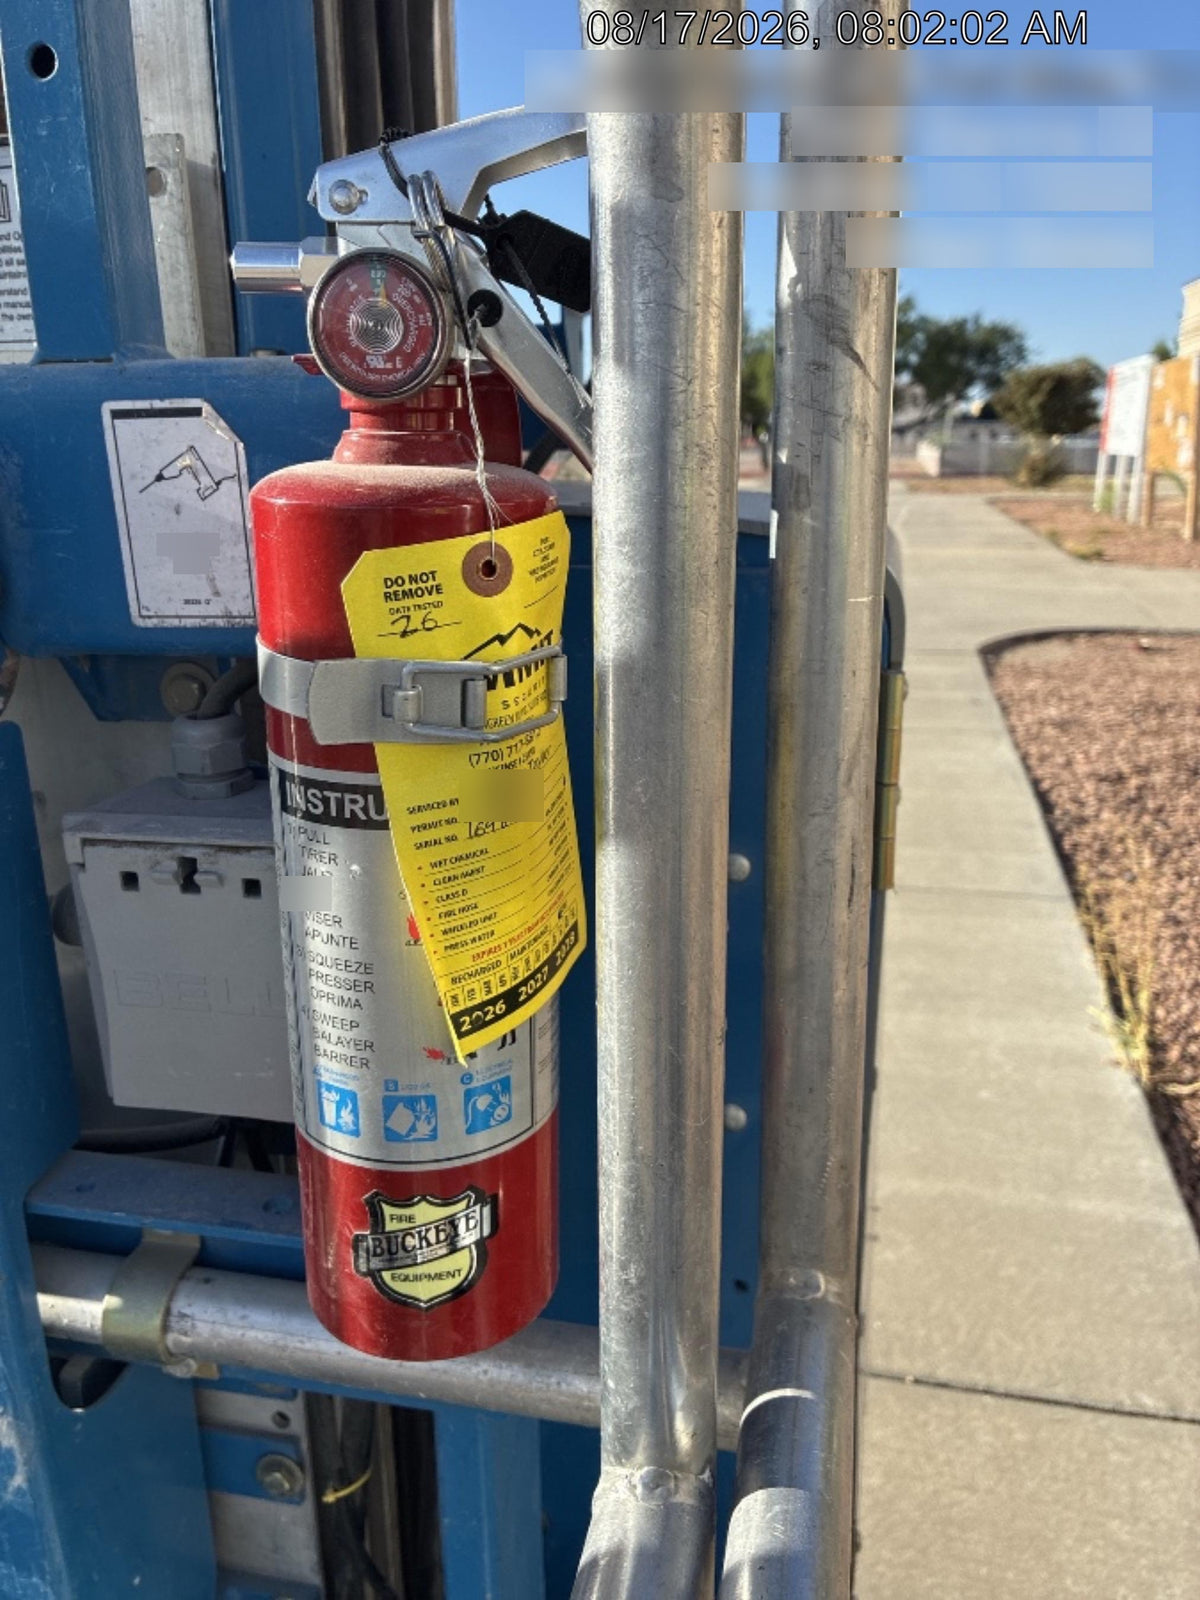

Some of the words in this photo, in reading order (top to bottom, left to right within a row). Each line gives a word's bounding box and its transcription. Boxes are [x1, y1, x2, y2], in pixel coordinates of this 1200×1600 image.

[383, 575, 405, 589] DO
[409, 571, 438, 586] NOT
[383, 583, 444, 603] REMOVE
[388, 605, 411, 616] DATE
[413, 601, 443, 613] TESTED
[298, 826, 331, 845] PULL
[305, 928, 359, 950] APUNTE
[308, 950, 374, 975] SQUEEZE
[450, 959, 502, 985] RECHARGED
[308, 968, 375, 994] PRESSER
[310, 986, 363, 1011] OPRIMA
[459, 999, 506, 1032] 2026
[518, 965, 549, 1001] 2027
[312, 1009, 360, 1032] SWEEP
[312, 1026, 375, 1053] BALAYER
[314, 1044, 371, 1070] BARRER
[389, 1213, 417, 1223] FIRE
[371, 1210, 480, 1257] BUCKEYE
[390, 1269, 463, 1282] EQUIPMENT
